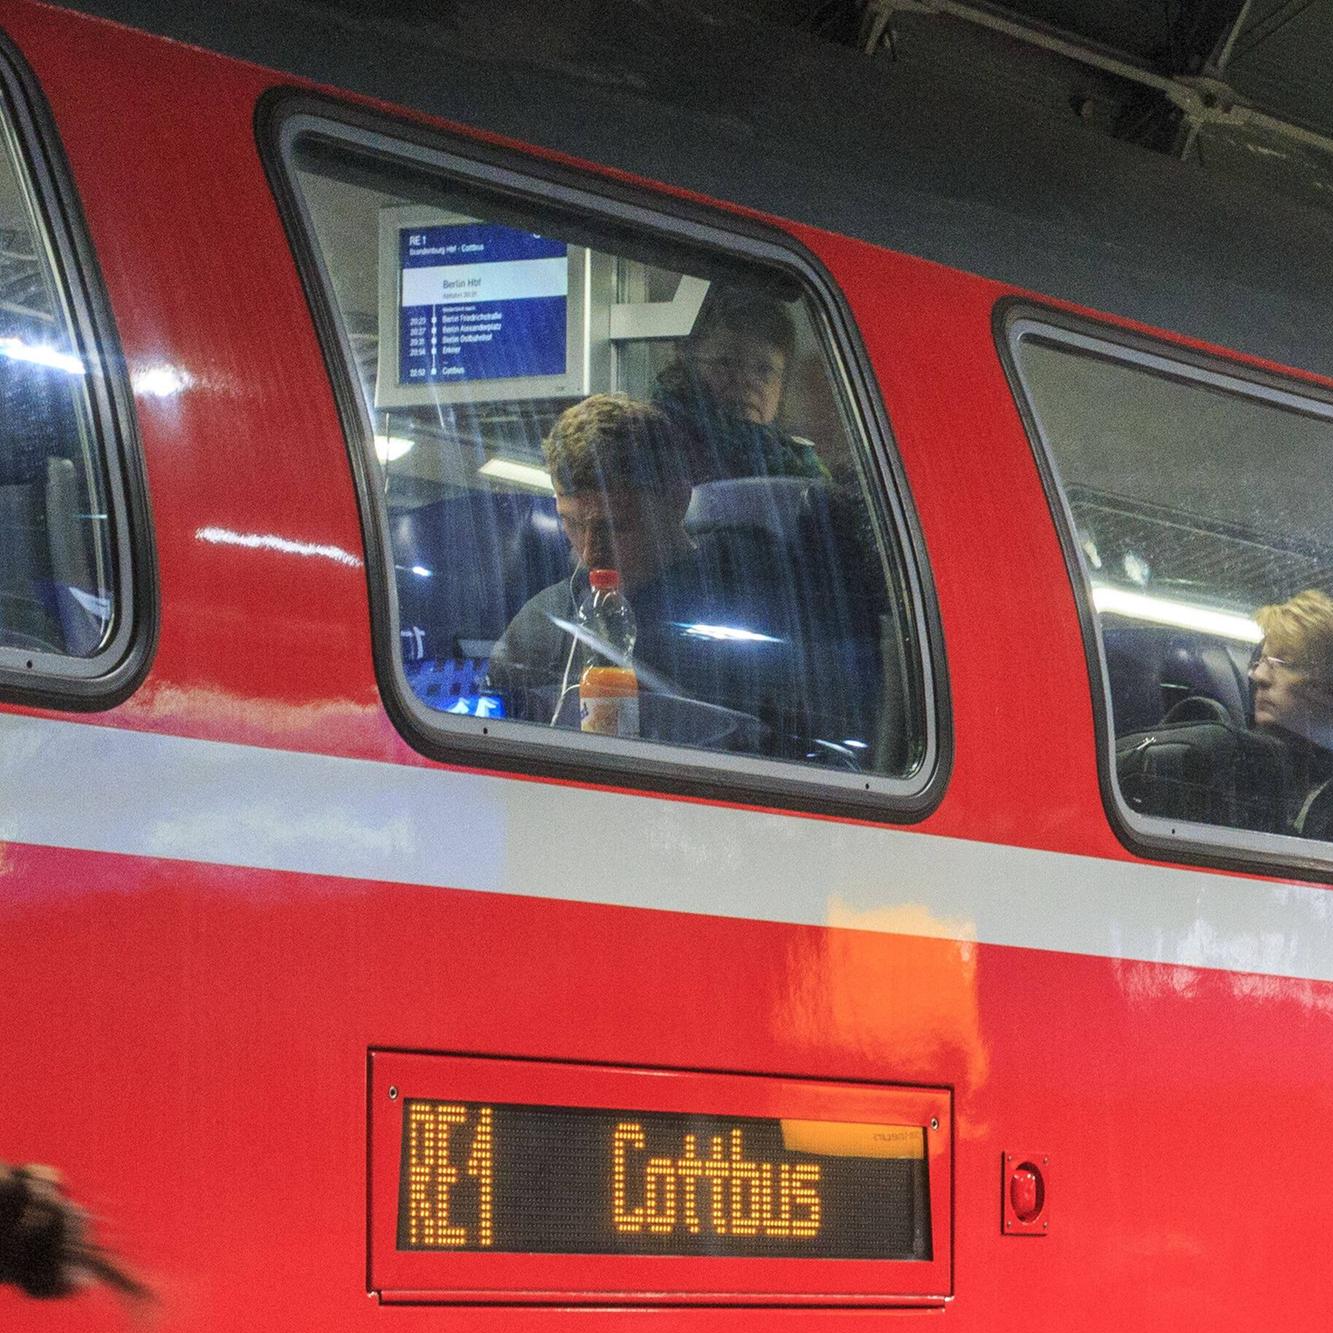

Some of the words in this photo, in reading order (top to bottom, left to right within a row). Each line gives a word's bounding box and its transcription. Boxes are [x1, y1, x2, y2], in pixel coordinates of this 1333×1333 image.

[409, 235, 421, 246] RE
[443, 280, 466, 289] Berlin
[467, 278, 482, 287] Hbf
[613, 1122, 822, 1237] Cottbus
